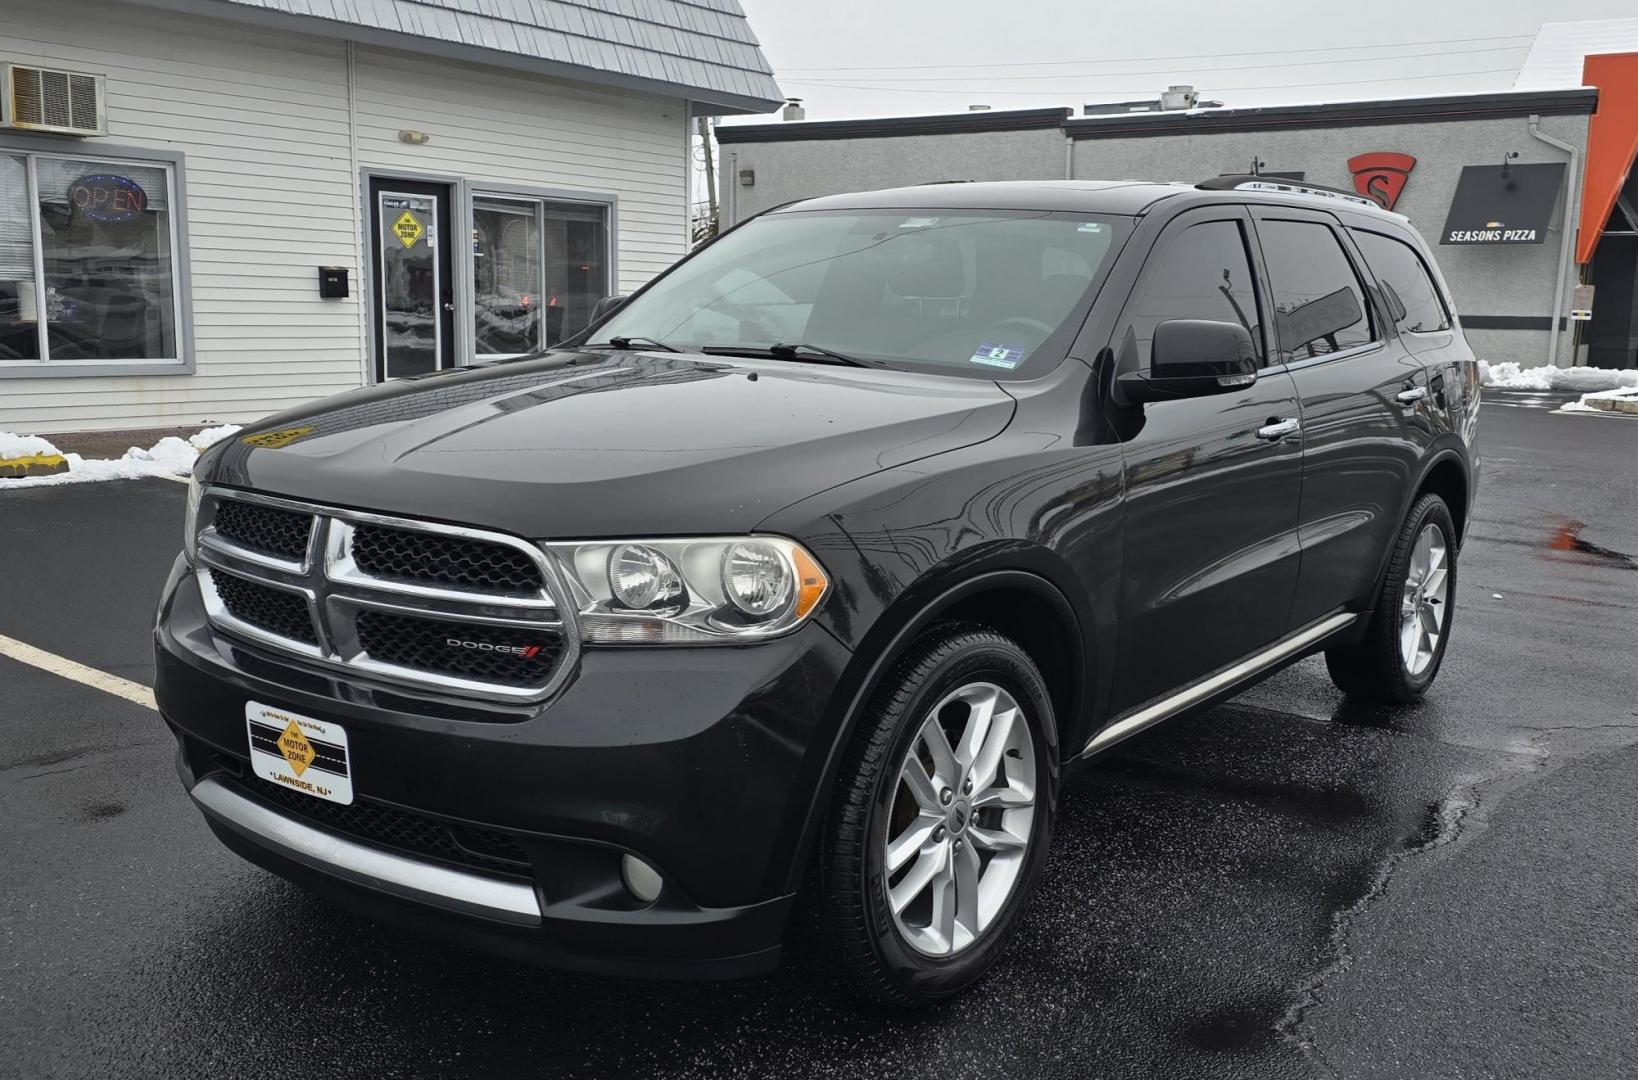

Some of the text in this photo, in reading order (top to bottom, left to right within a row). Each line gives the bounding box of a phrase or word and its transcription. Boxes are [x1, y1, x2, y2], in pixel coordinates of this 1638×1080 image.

[74, 186, 144, 210] OPEN
[398, 223, 418, 231] MOTOR
[400, 231, 416, 239] ZONE
[1449, 229, 1536, 242] SEASONS PIZZA
[994, 349, 1004, 358] 2
[446, 638, 528, 656] DODGE
[290, 731, 299, 739] THE
[283, 738, 309, 754] MOTOR
[287, 750, 307, 764] ZONE
